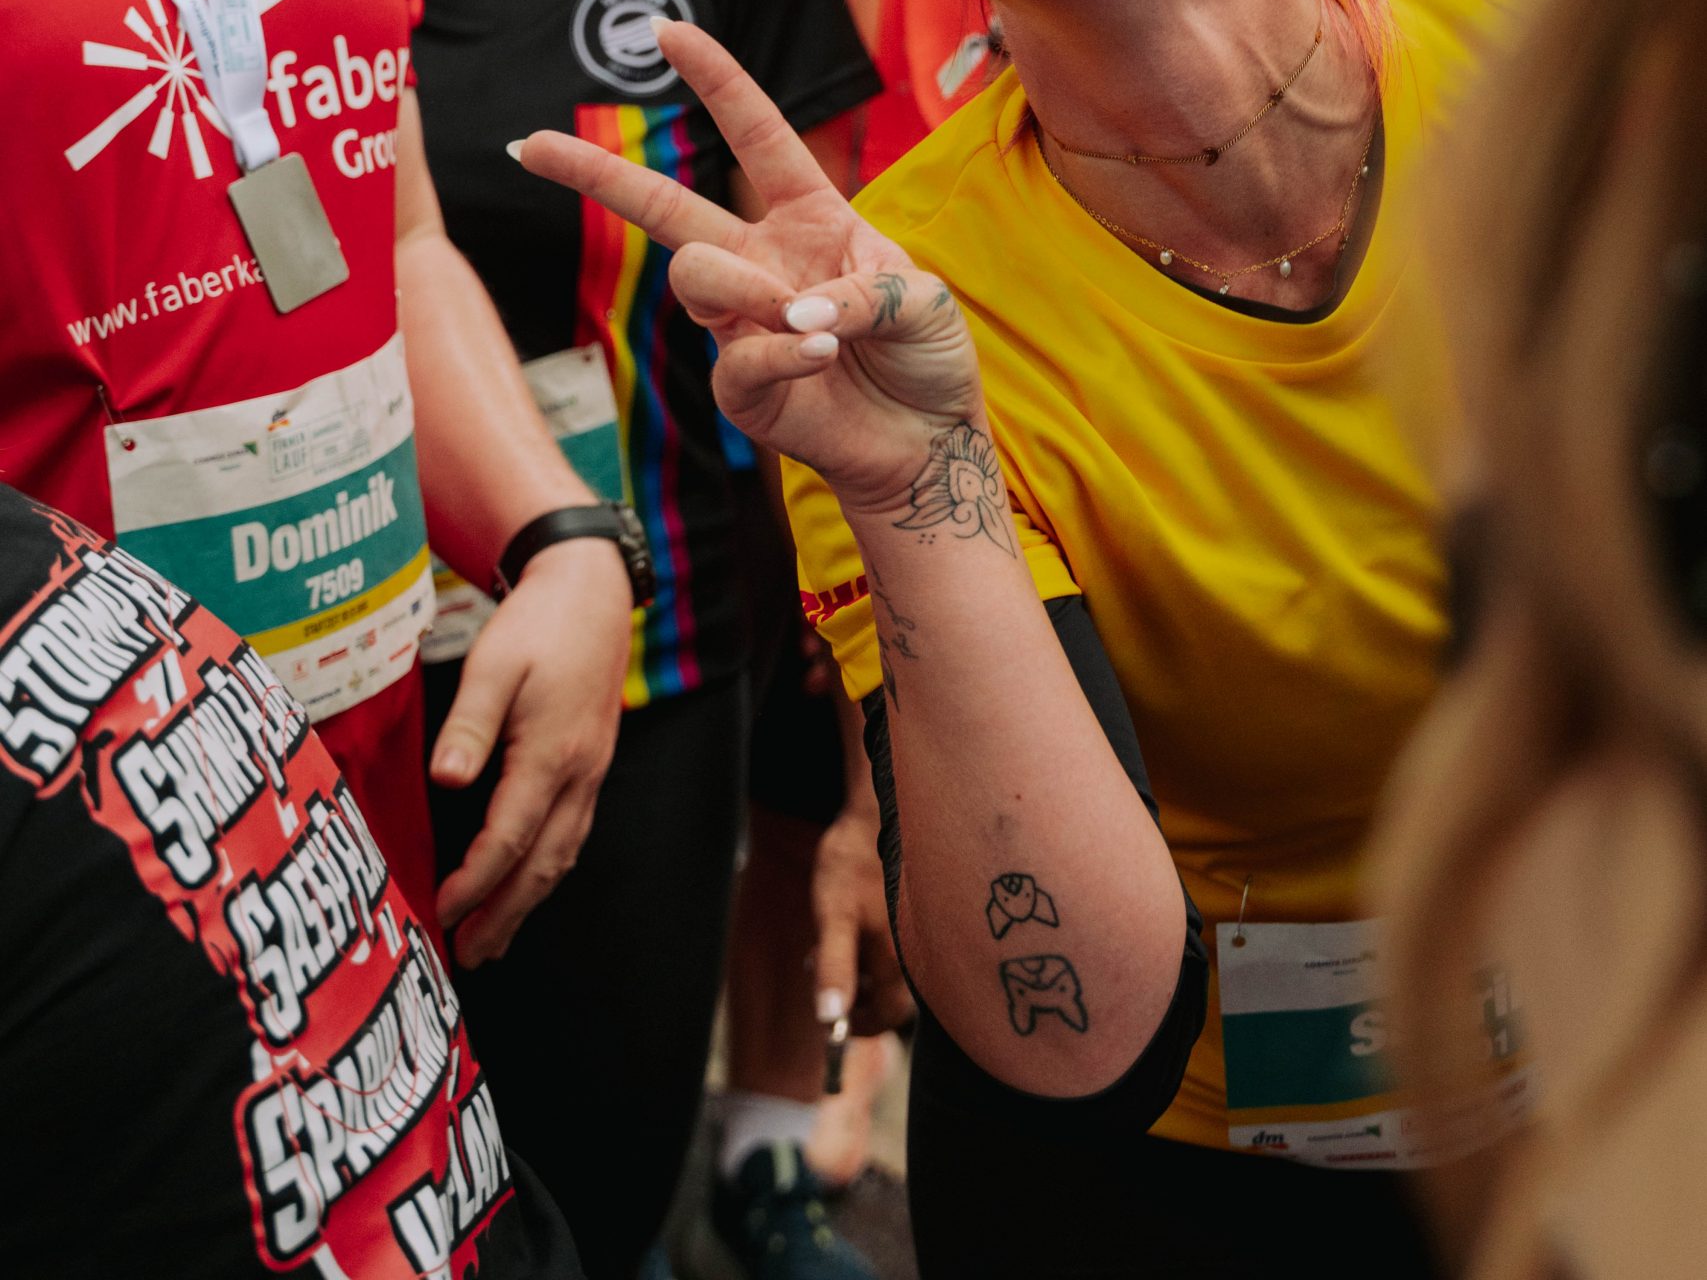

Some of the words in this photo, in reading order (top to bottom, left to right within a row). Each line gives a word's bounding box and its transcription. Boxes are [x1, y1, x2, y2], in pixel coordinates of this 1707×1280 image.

[267, 34, 410, 128] faber
[230, 471, 398, 584] Dominik
[305, 558, 364, 610] 7509
